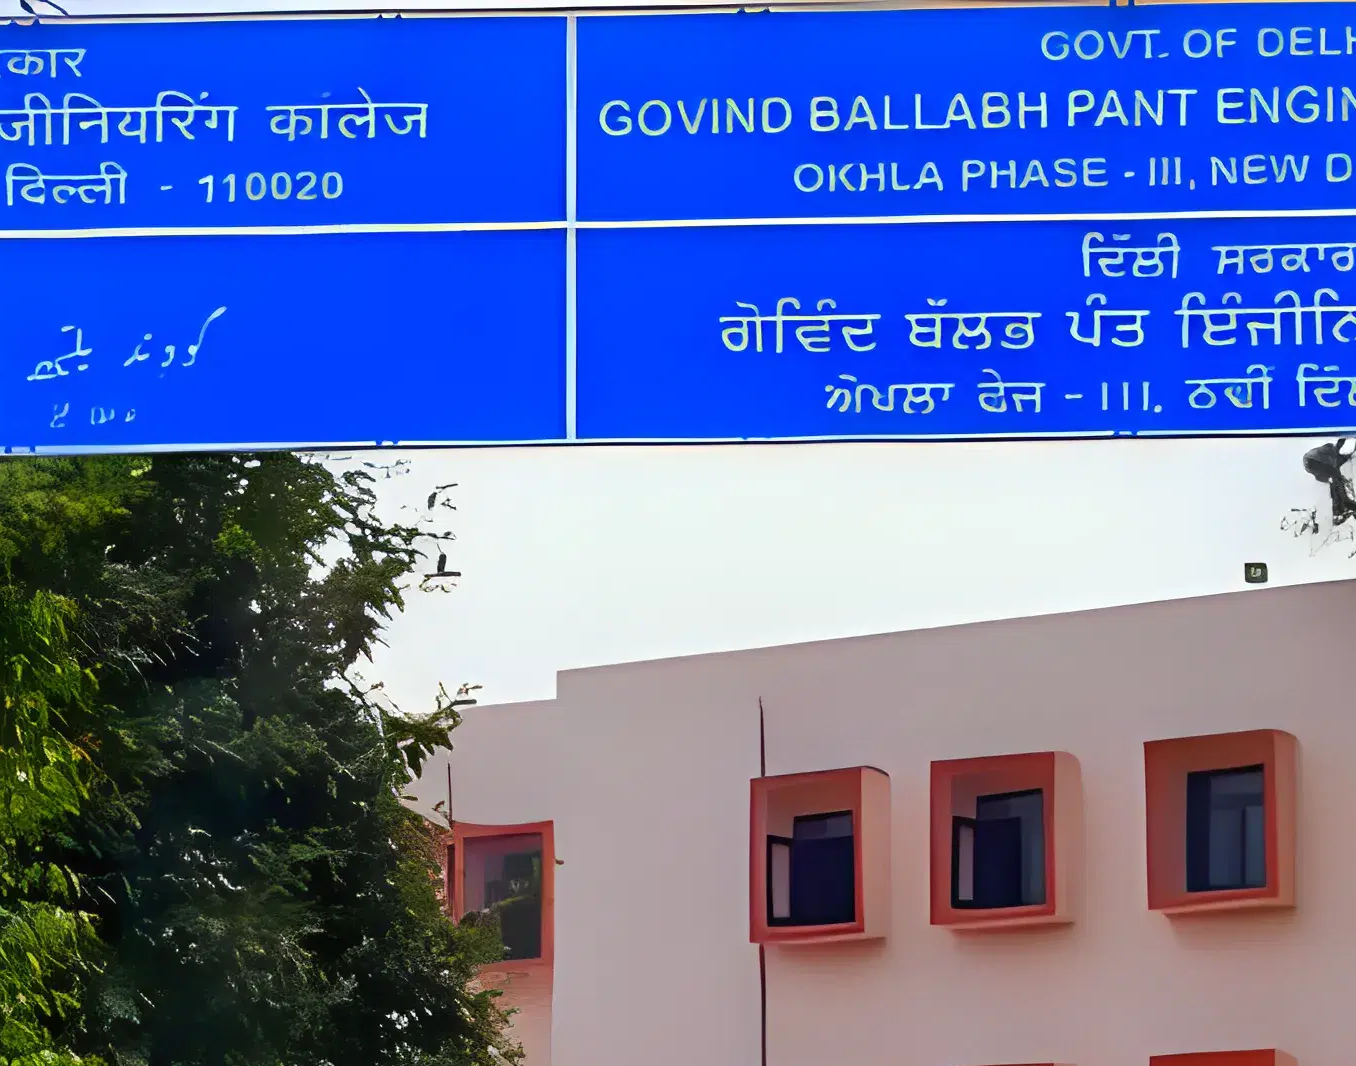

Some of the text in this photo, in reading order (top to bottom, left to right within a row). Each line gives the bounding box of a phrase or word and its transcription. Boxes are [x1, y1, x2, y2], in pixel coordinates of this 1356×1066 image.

[1182, 28, 1237, 59] OF
[598, 96, 793, 137] GOVIND
[809, 91, 1048, 132] BALLABH
[1067, 88, 1198, 127] PANT
[5, 161, 128, 207] दिल्ली
[198, 170, 343, 203] 110020
[793, 161, 944, 193] OKHLA
[962, 157, 1110, 192] PHASE
[1210, 152, 1310, 186] NEW
[1081, 231, 1181, 279] ਦਿੱਲੀ
[718, 296, 882, 354] ਗੋਵਿੰਦ
[904, 298, 1043, 350] ਬੱਲਭ
[1065, 293, 1151, 348] ਪੰਤ
